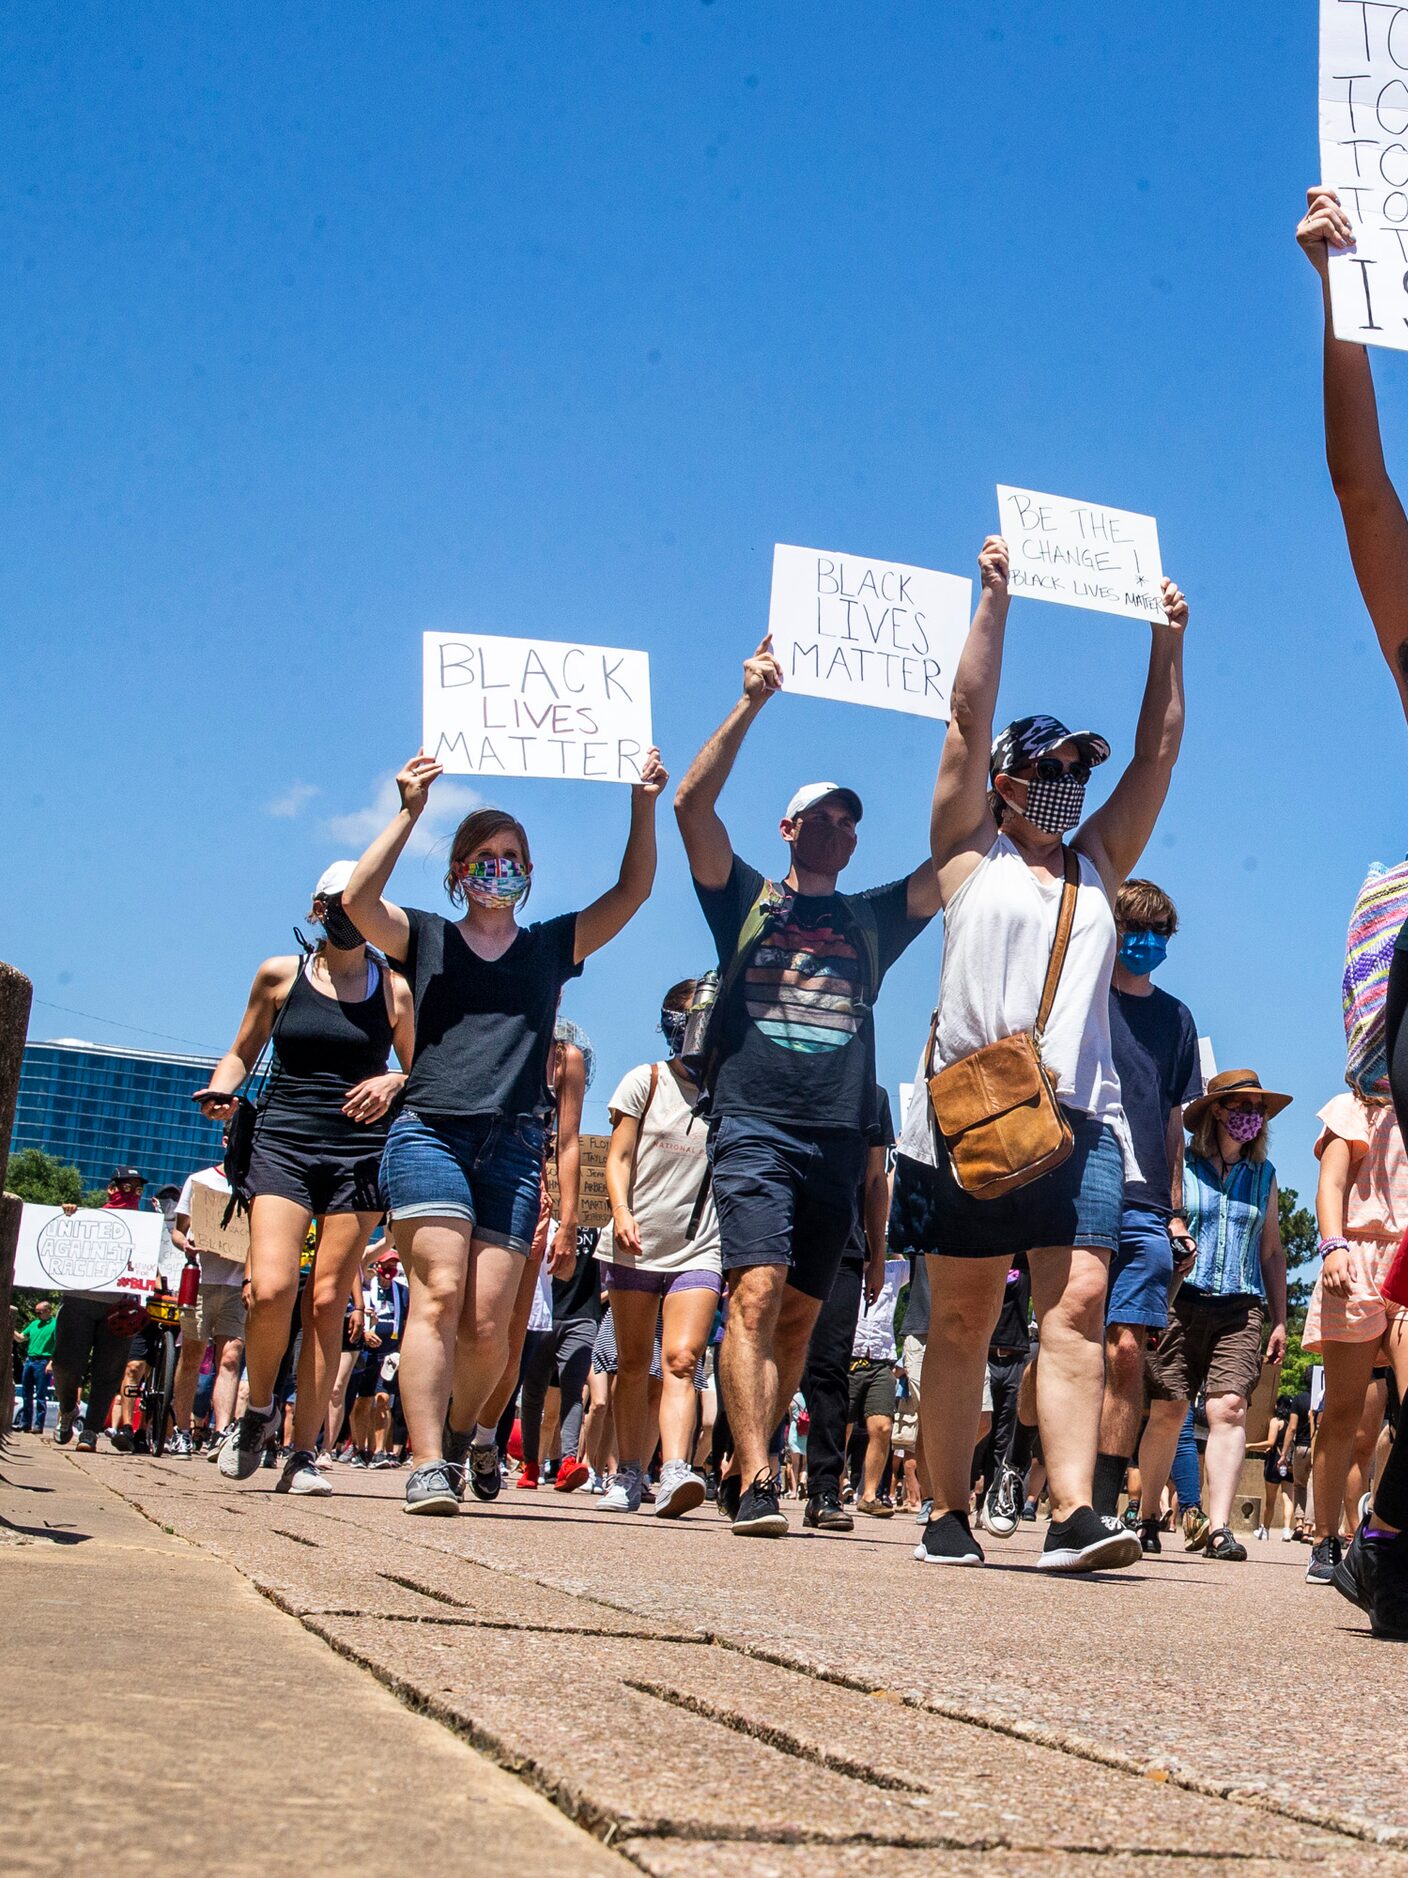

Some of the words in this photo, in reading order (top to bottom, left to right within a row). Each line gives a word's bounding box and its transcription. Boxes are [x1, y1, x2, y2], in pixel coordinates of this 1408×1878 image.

[1349, 259, 1383, 330] I
[1008, 495, 1058, 532] BE
[1071, 508, 1135, 544] THE
[817, 558, 916, 606] BLACK
[1009, 569, 1066, 591] BLACK
[1073, 580, 1121, 602] LIVES
[1125, 592, 1166, 614] MATTER
[817, 596, 929, 656] LIVES
[439, 643, 633, 702] BLACK
[792, 641, 944, 700] MATTER
[483, 696, 599, 735] LIVES
[434, 731, 643, 780] MATTER
[41, 1239, 136, 1261] AGAINST
[46, 1220, 126, 1240] UNITED
[49, 1258, 124, 1279] RACISM
